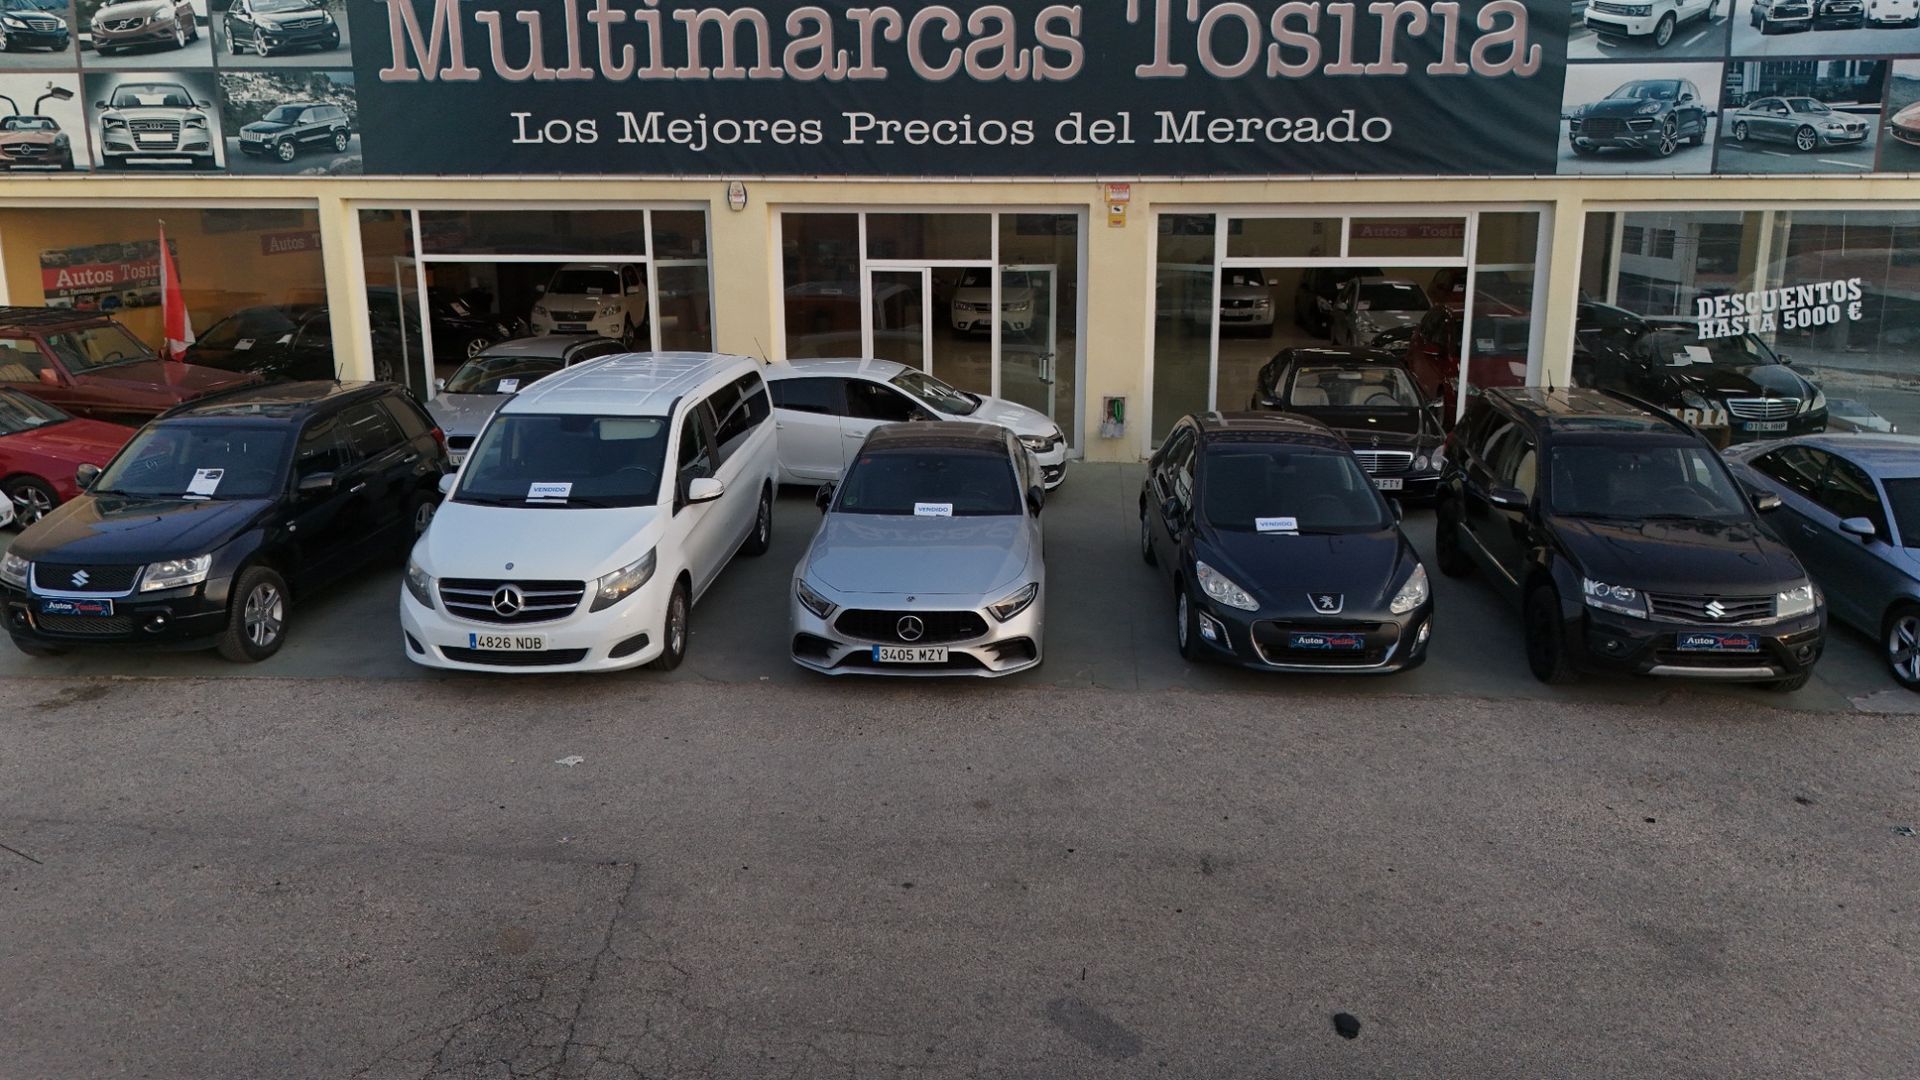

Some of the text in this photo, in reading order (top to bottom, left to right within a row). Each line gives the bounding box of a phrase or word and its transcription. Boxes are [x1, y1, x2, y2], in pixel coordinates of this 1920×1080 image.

[378, 0, 1543, 83] Multimarcas Tosiria
[511, 110, 1392, 152] Los Mejores Precios del Mercado
[1360, 225, 1464, 238] Autos Tosir
[270, 236, 305, 252] Autos
[56, 261, 161, 288] Autos Tosir
[1697, 277, 1862, 320] DESCUENTOS
[1697, 300, 1862, 340] HASTA 5000 €
[49, 601, 72, 609] Autos
[478, 635, 542, 649] 4826 NDB
[1298, 636, 1324, 644] Autos
[1687, 637, 1714, 645] Autos
[881, 648, 943, 661] 3405 MZY
